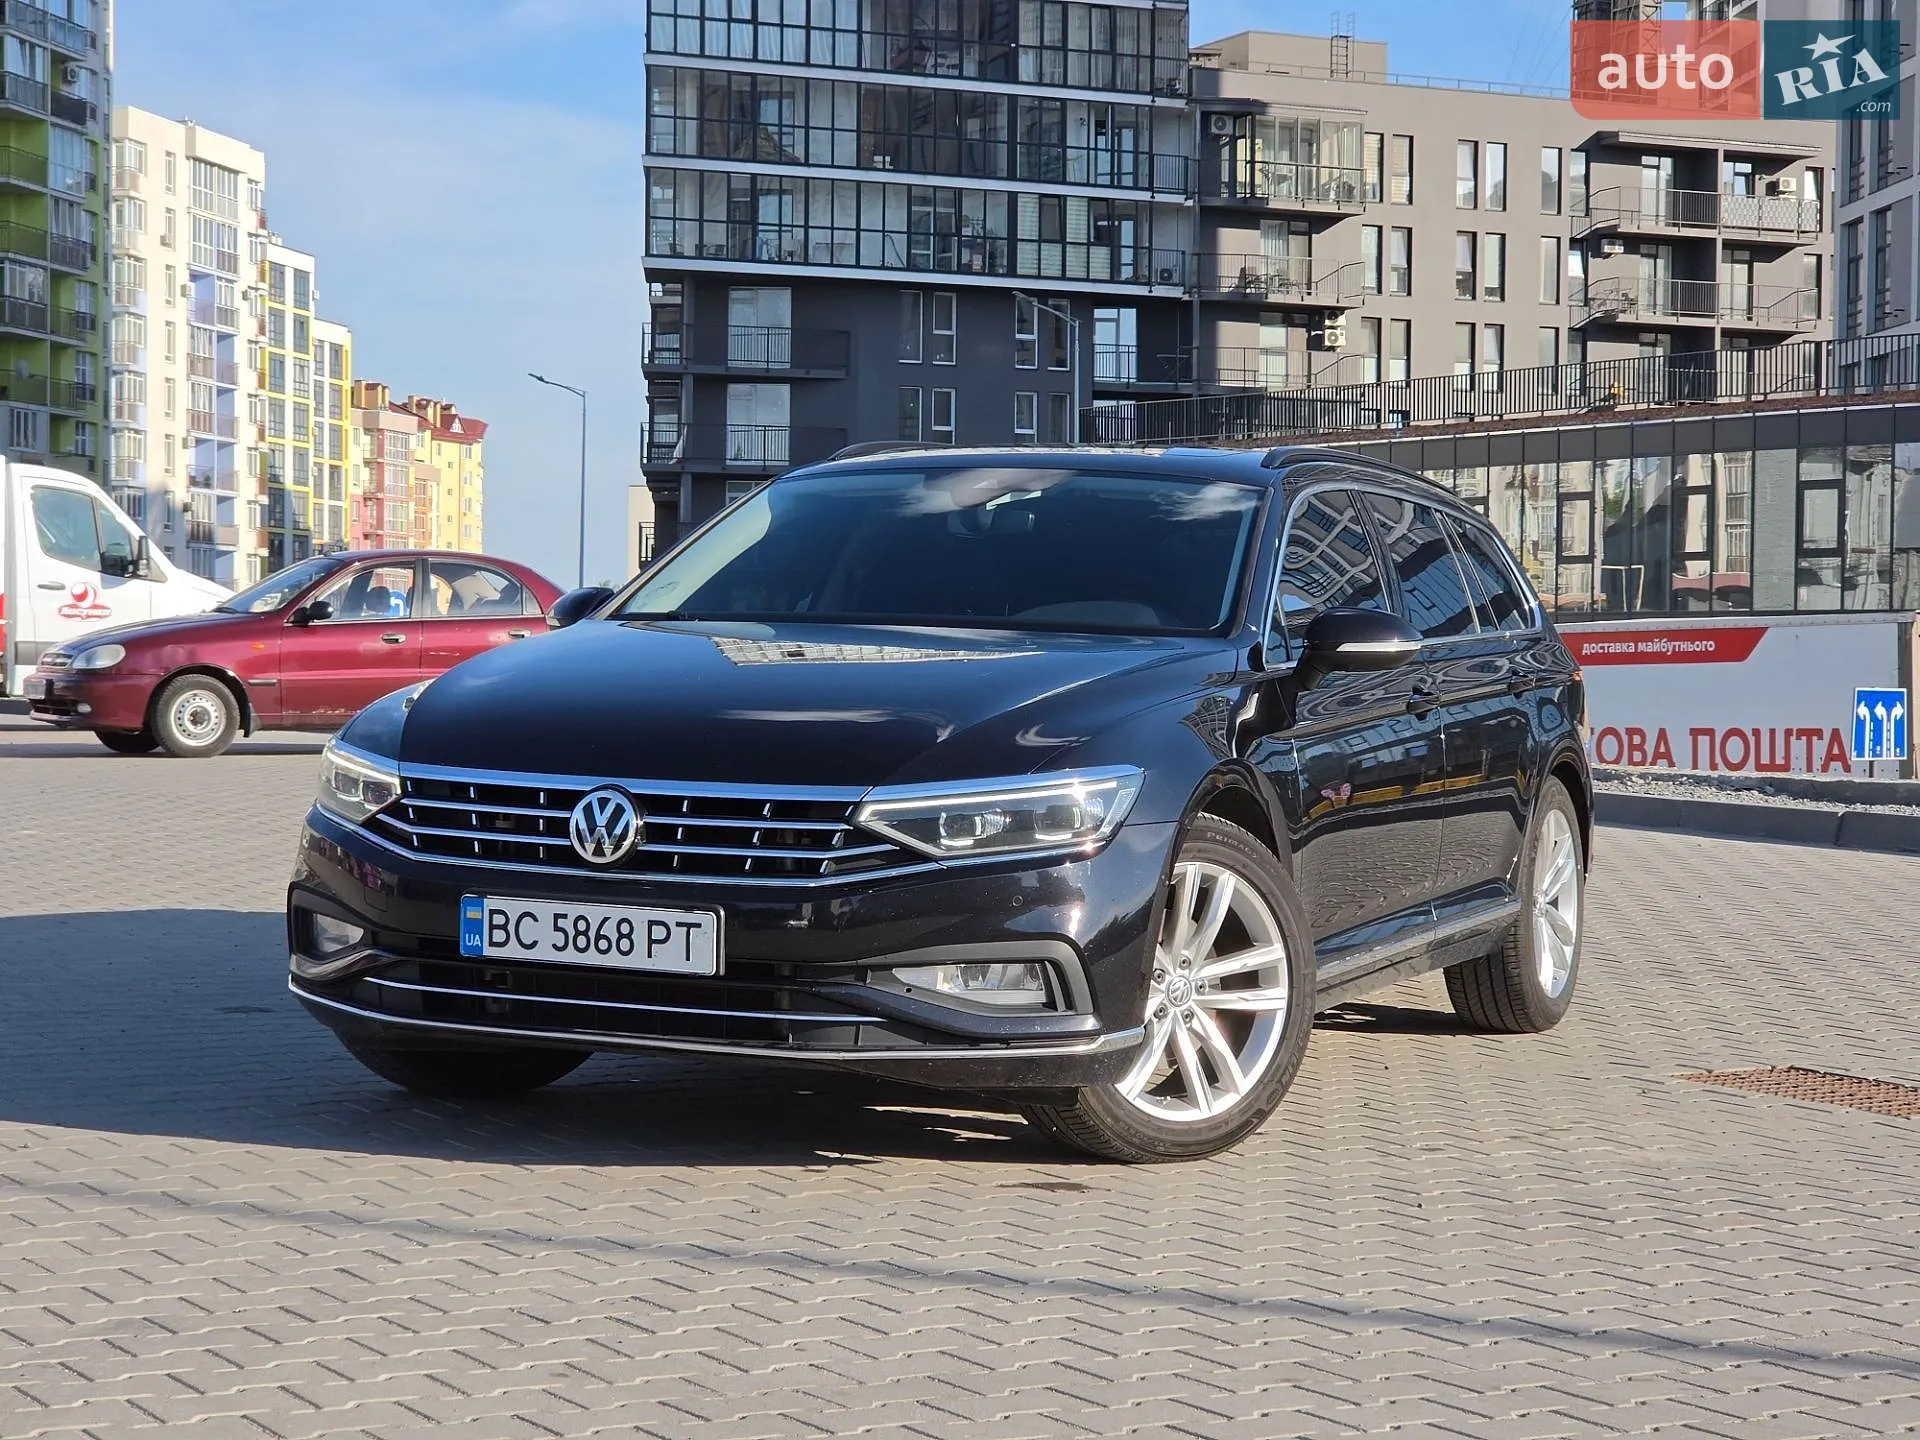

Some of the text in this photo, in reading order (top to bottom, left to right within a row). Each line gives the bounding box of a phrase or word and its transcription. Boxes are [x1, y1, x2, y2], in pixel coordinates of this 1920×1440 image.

[1582, 638, 1716, 656] доставка майбутнього
[1591, 726, 1852, 773] ОВА ПОШТА
[465, 933, 482, 947] UA
[488, 908, 703, 962] BC 5868 PT
